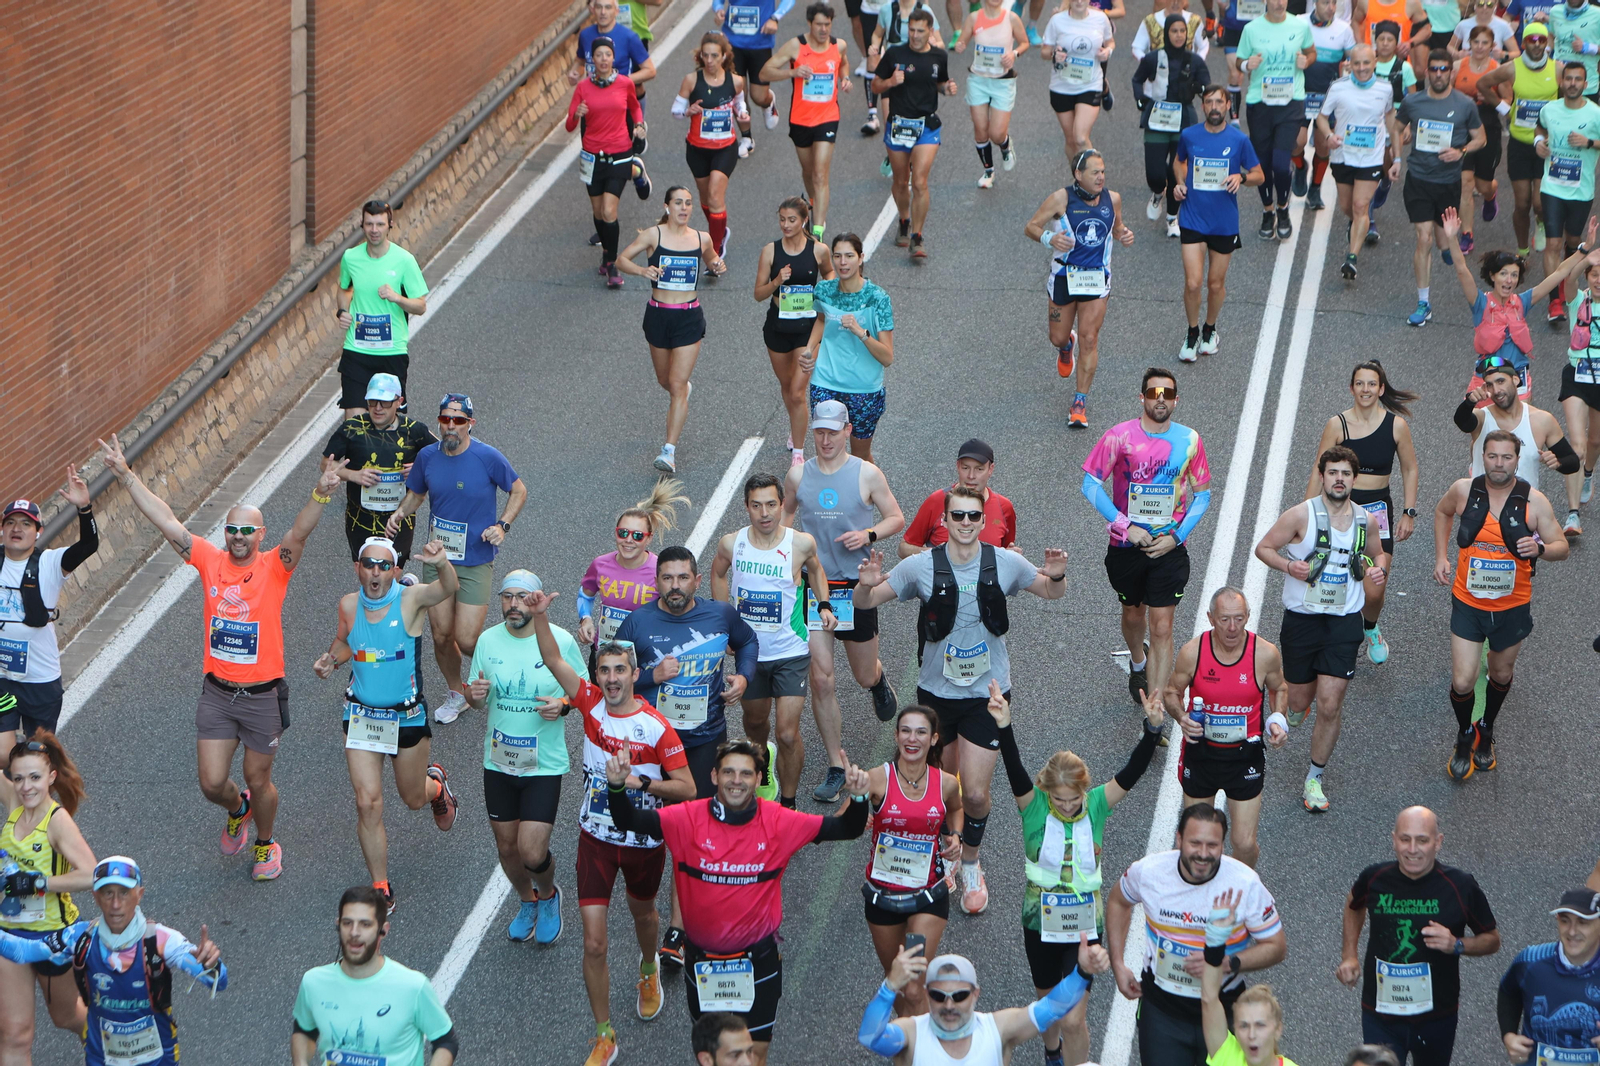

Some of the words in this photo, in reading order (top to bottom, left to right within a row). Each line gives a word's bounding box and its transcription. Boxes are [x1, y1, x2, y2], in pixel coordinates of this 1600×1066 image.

[1073, 57, 1091, 65] ZURICH
[1430, 123, 1449, 131] ZURICH
[1154, 459, 1171, 468] am
[376, 487, 392, 495] 9523
[1142, 499, 1161, 507] 10372
[1139, 508, 1163, 516] KENERGY
[438, 521, 462, 531] ZURICH
[436, 534, 450, 543] 9183
[736, 559, 784, 578] PORTUGAL
[1484, 562, 1510, 571] ZURICH
[1482, 575, 1501, 583] 10050
[599, 574, 657, 604] KATIE
[1471, 580, 1487, 588] RICAR
[1488, 582, 1511, 590] PACHECO
[751, 593, 777, 601] ZURICH
[749, 606, 768, 614] 12956
[740, 612, 762, 622] RICARDO
[226, 622, 253, 632] ZURICH
[223, 636, 244, 646] 12345
[218, 643, 250, 654] ALEXANDRU
[958, 647, 985, 658] ZURICH
[680, 653, 705, 661] ZURICH
[959, 662, 976, 670] 9438
[677, 689, 704, 698] ZURICH
[675, 703, 692, 711] 9038
[1213, 703, 1254, 714] Lentos
[367, 710, 394, 719] ZURICH
[1212, 718, 1240, 726] ZURICH
[365, 723, 385, 733] 11116
[1212, 733, 1229, 741] 8957
[504, 738, 532, 746] ZURICH
[504, 750, 520, 759] 9027
[902, 830, 937, 841] Lentos
[897, 842, 927, 852] ZURICH
[893, 855, 912, 865] 9116
[700, 858, 723, 872] Los
[722, 861, 766, 873] Lentos
[891, 865, 912, 875] BIENVE
[703, 874, 723, 884] CLUB
[724, 876, 736, 884] DE
[1394, 898, 1439, 908] POPULAR
[1061, 913, 1079, 921] 9092
[1159, 908, 1207, 924] IMPREXION
[1062, 923, 1079, 931] MARI
[716, 962, 747, 973] ZURICH
[1391, 967, 1422, 976] ZURICH
[718, 980, 736, 989] 8878
[1392, 984, 1411, 993] 8974
[714, 990, 742, 999] PEÑUELA
[1391, 994, 1413, 1003] TOMÁS
[116, 1021, 148, 1035] ZURICH
[132, 1043, 157, 1055] MARTEL
[346, 1056, 379, 1066] ZURICH
[1558, 1052, 1593, 1062] ZURICH
